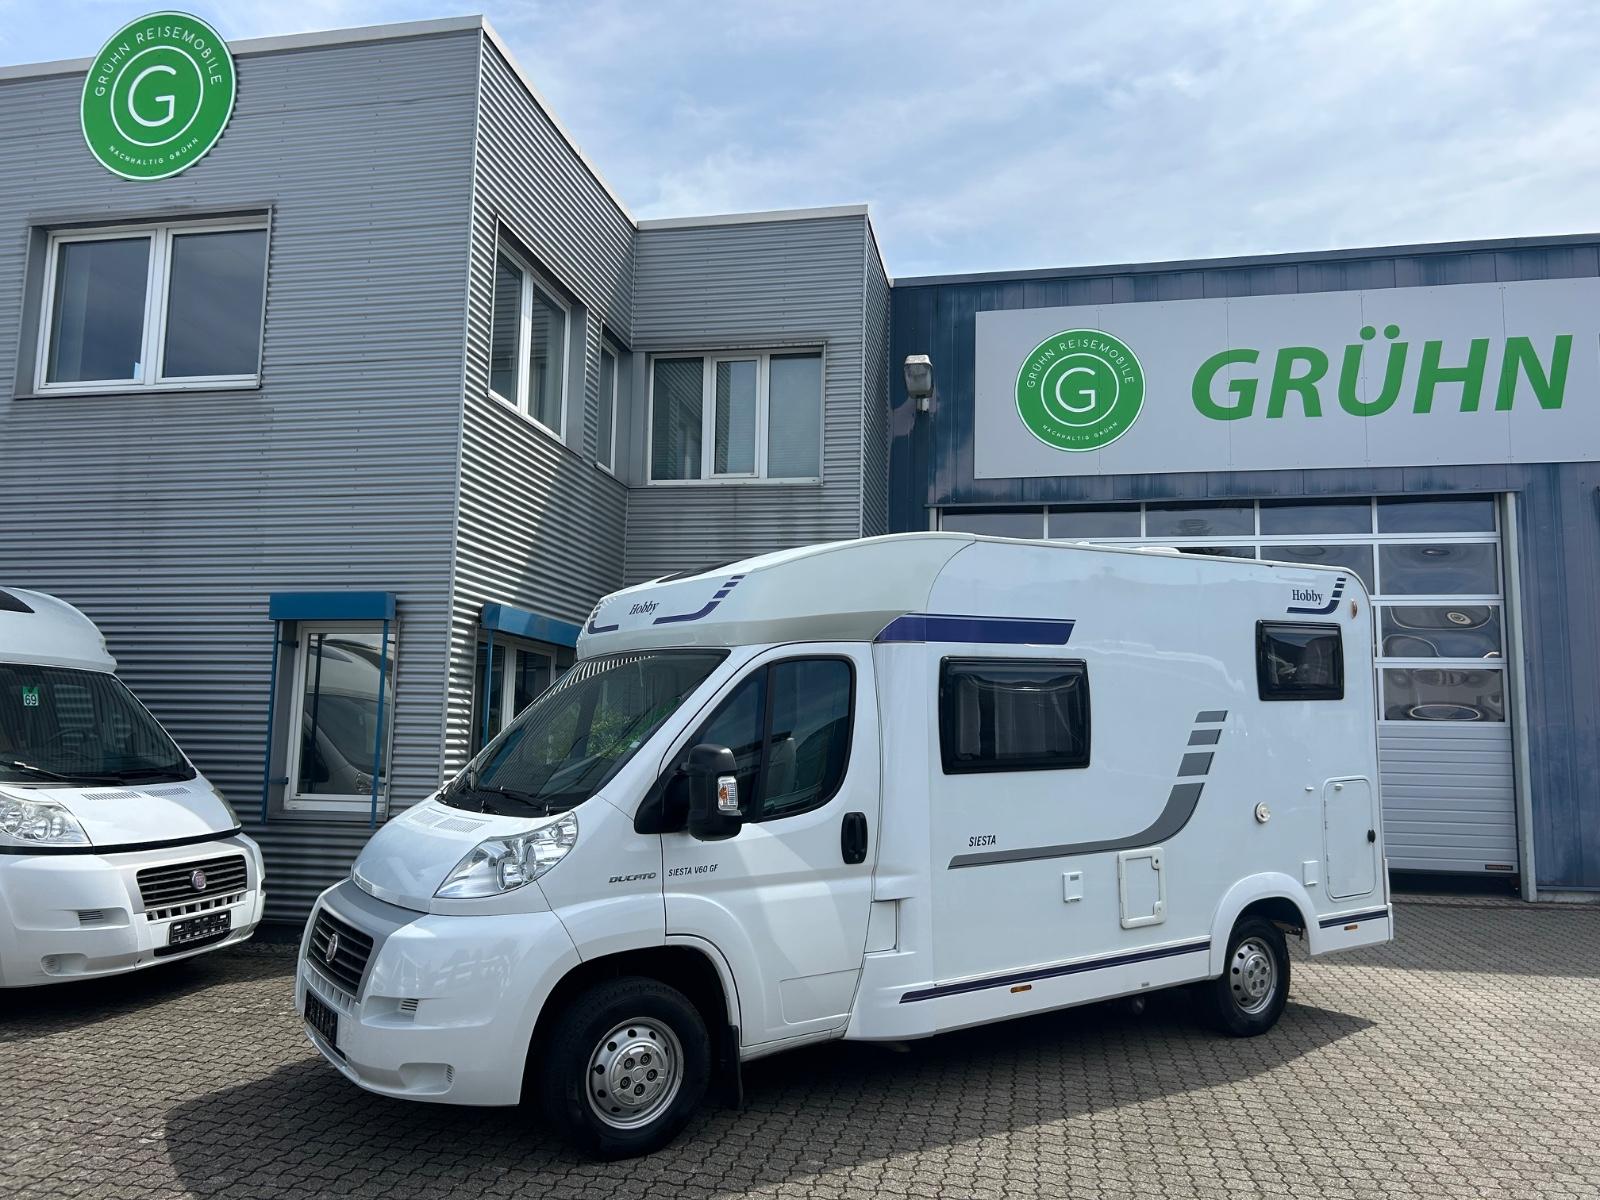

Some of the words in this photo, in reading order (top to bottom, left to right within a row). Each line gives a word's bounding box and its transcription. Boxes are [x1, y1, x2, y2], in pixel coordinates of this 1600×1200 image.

[94, 43, 131, 97] GRÜHN
[136, 26, 222, 86] REISEMOBILE
[127, 65, 177, 127] G
[108, 145, 165, 165] NACHHALTIG
[169, 137, 199, 160] GRÜHN
[1027, 349, 1055, 388] GRÜHN
[1059, 339, 1135, 384] REISEMOBILE
[1192, 324, 1573, 421] GRÜHN
[1055, 367, 1096, 413] G
[629, 600, 660, 615] Hobby
[1292, 589, 1323, 605] Hobby
[24, 694, 37, 706] 69
[968, 835, 996, 847] SIESTA
[609, 872, 657, 883] DUCATO
[668, 866, 692, 877] SIESTA
[694, 865, 708, 874] V60
[709, 863, 718, 872] GF
